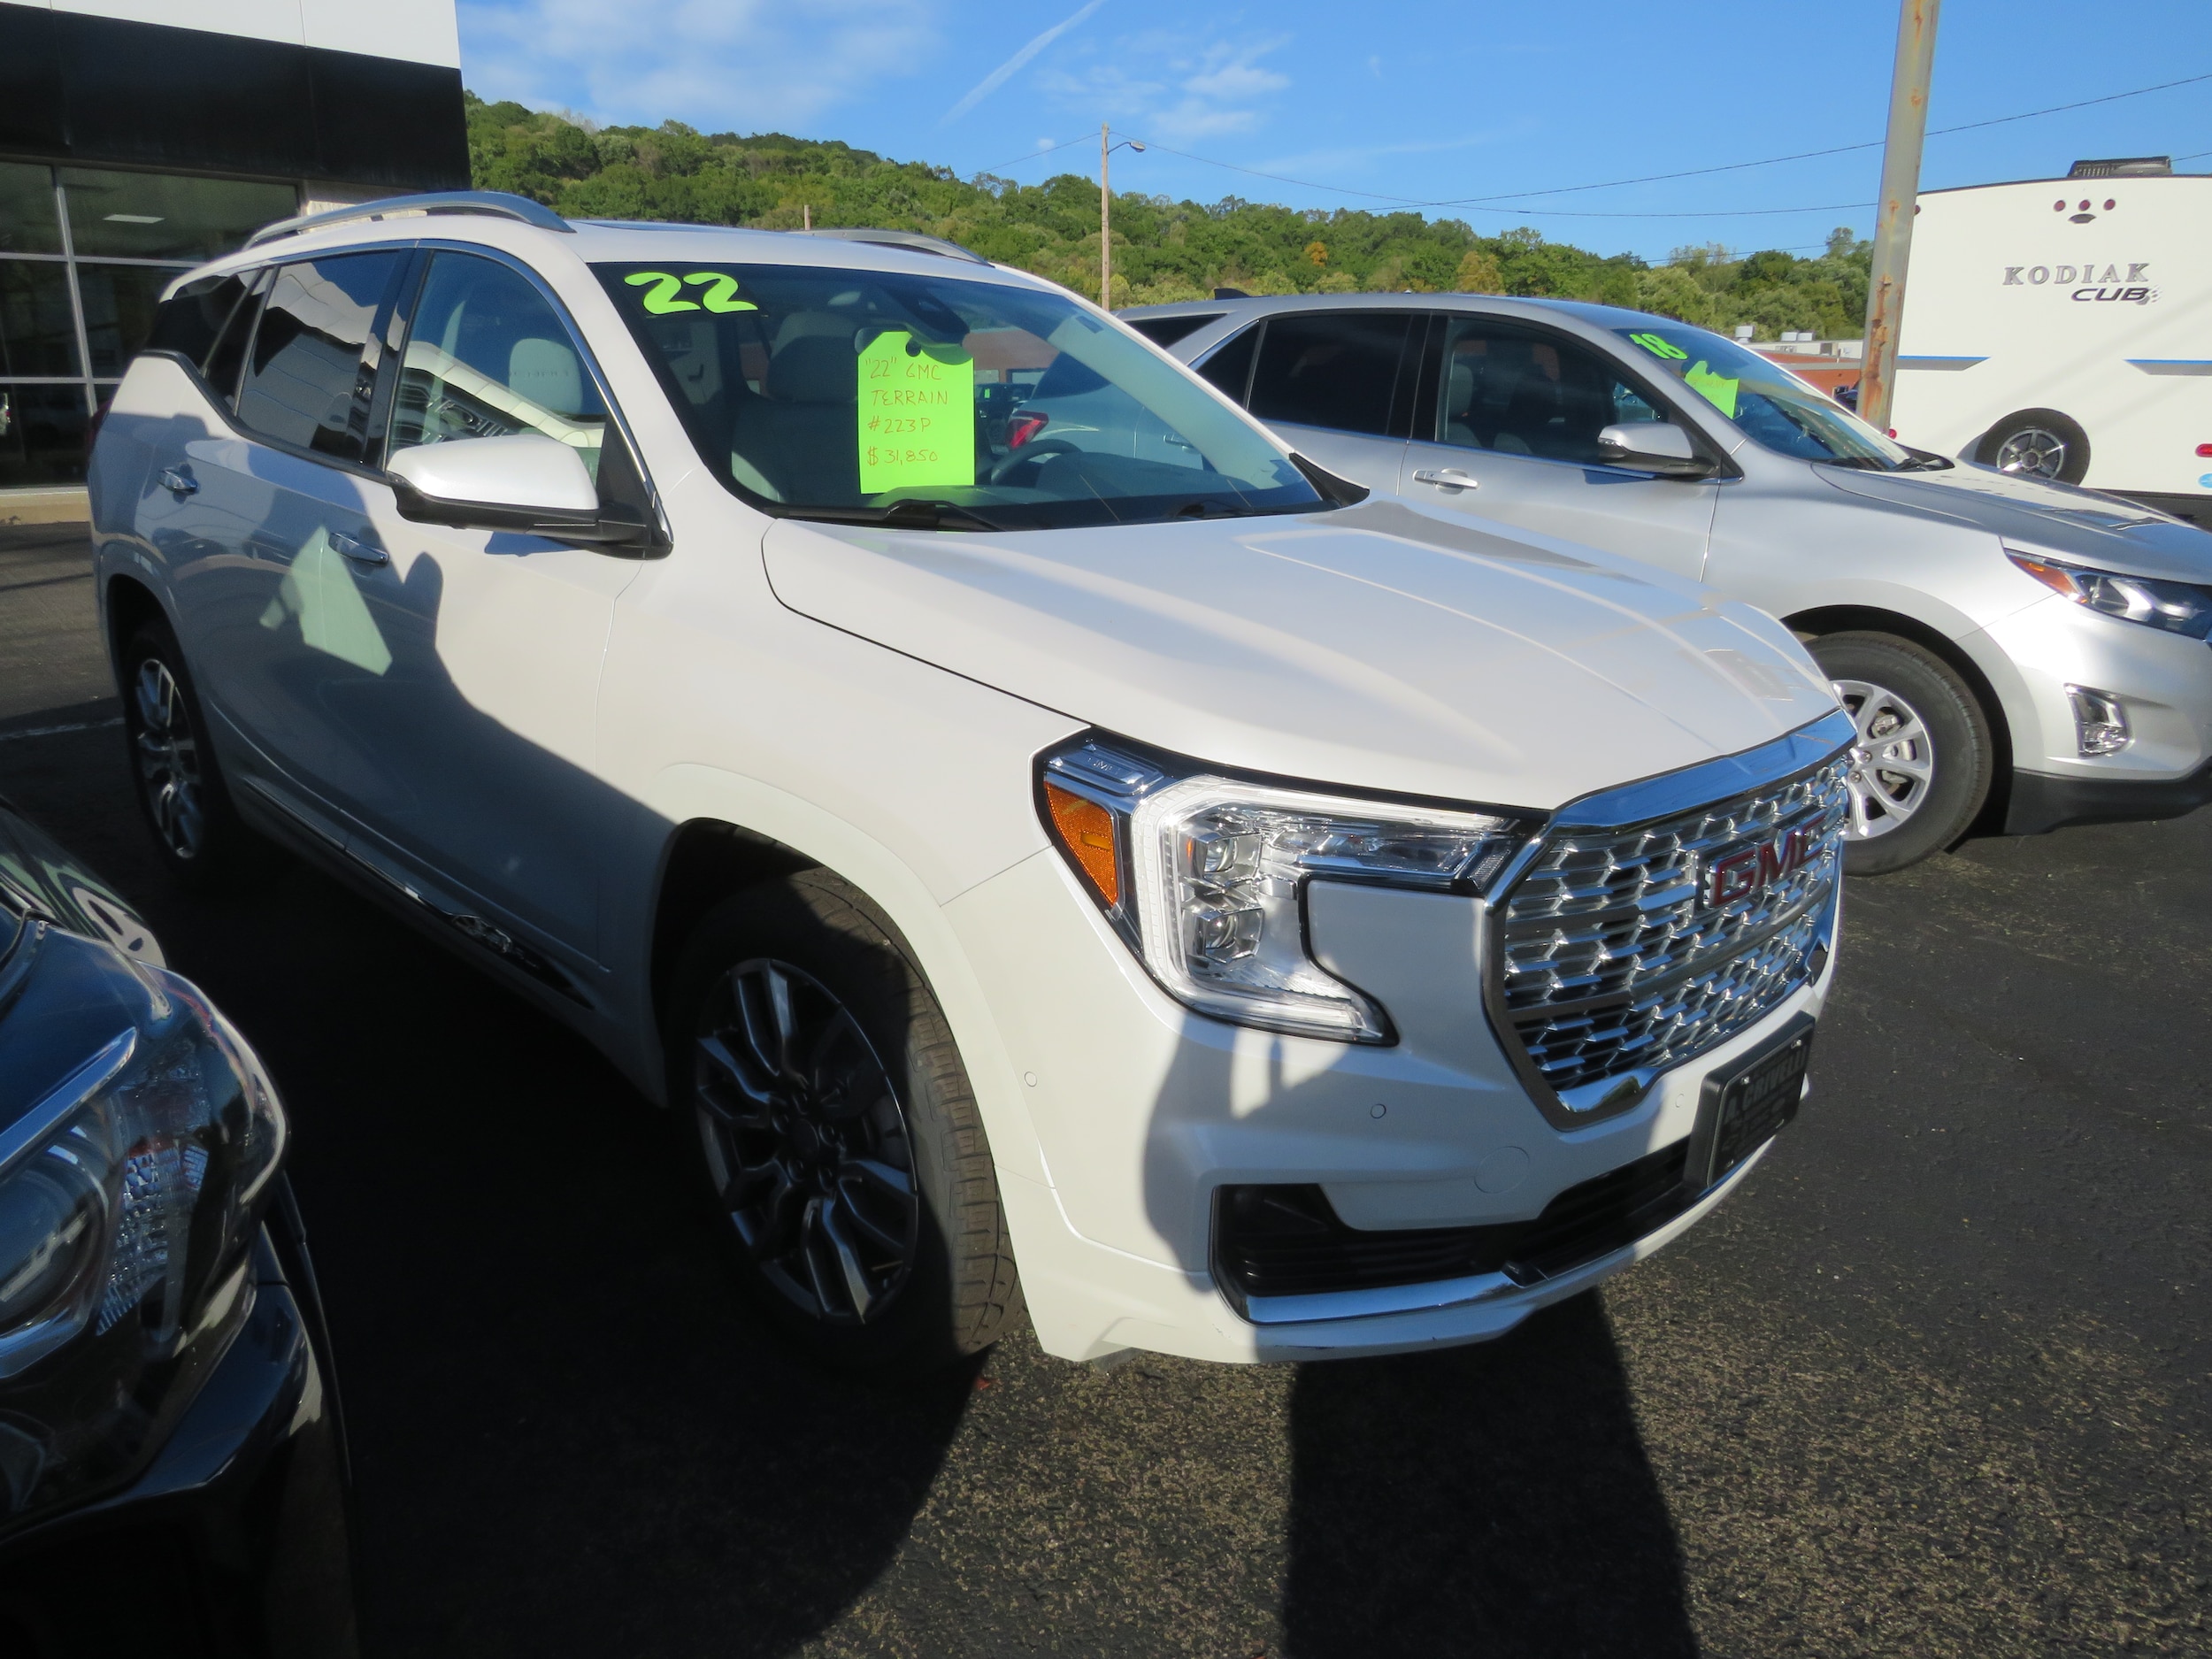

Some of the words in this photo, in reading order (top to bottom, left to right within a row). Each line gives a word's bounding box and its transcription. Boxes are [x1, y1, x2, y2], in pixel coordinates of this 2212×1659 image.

[2002, 263, 2149, 285] KODIAK
[625, 272, 758, 314] 22
[2071, 288, 2149, 302] CUB
[1629, 333, 1688, 360] 18
[865, 357, 897, 379] "22"
[906, 363, 941, 380] GMC
[872, 389, 949, 406] TERRAIN
[1714, 810, 1826, 908] GMC
